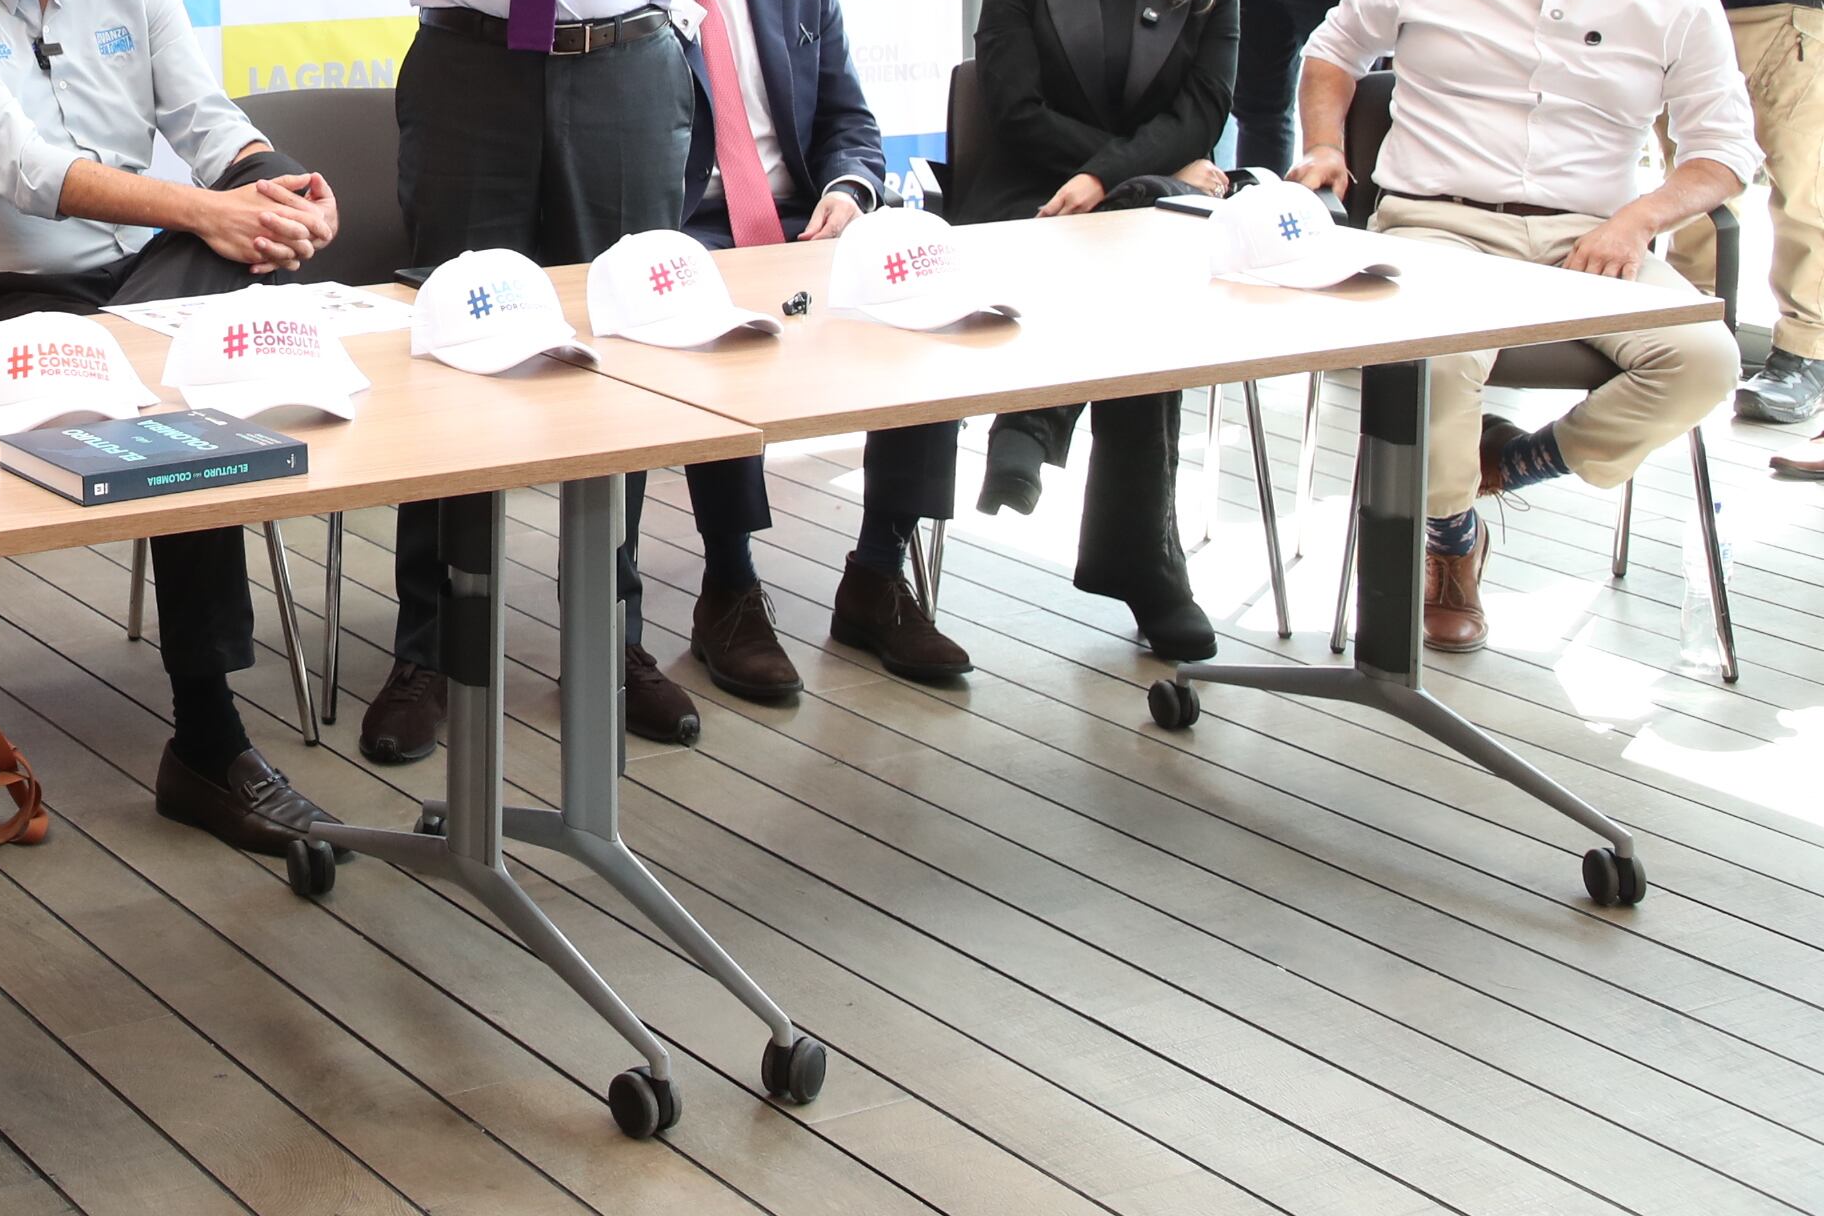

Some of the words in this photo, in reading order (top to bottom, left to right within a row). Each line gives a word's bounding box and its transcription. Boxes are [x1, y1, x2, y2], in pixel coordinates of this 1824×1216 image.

[248, 67, 290, 95] LA
[295, 59, 394, 91] GRAN
[907, 246, 927, 260] LA
[670, 256, 687, 270] LA
[253, 322, 274, 336] LA
[276, 321, 318, 337] GRAN
[253, 335, 320, 349] CONSULTA
[37, 344, 60, 356] LA
[62, 344, 107, 360] GRAN
[255, 346, 278, 355] POR
[38, 356, 109, 373] CONSULTA
[40, 369, 61, 377] POR
[137, 419, 219, 451] COLOMBIA
[61, 428, 129, 459] FUTURO
[203, 464, 238, 479] FUTURO
[236, 463, 249, 474] EL
[147, 471, 192, 487] COLOMBIA
